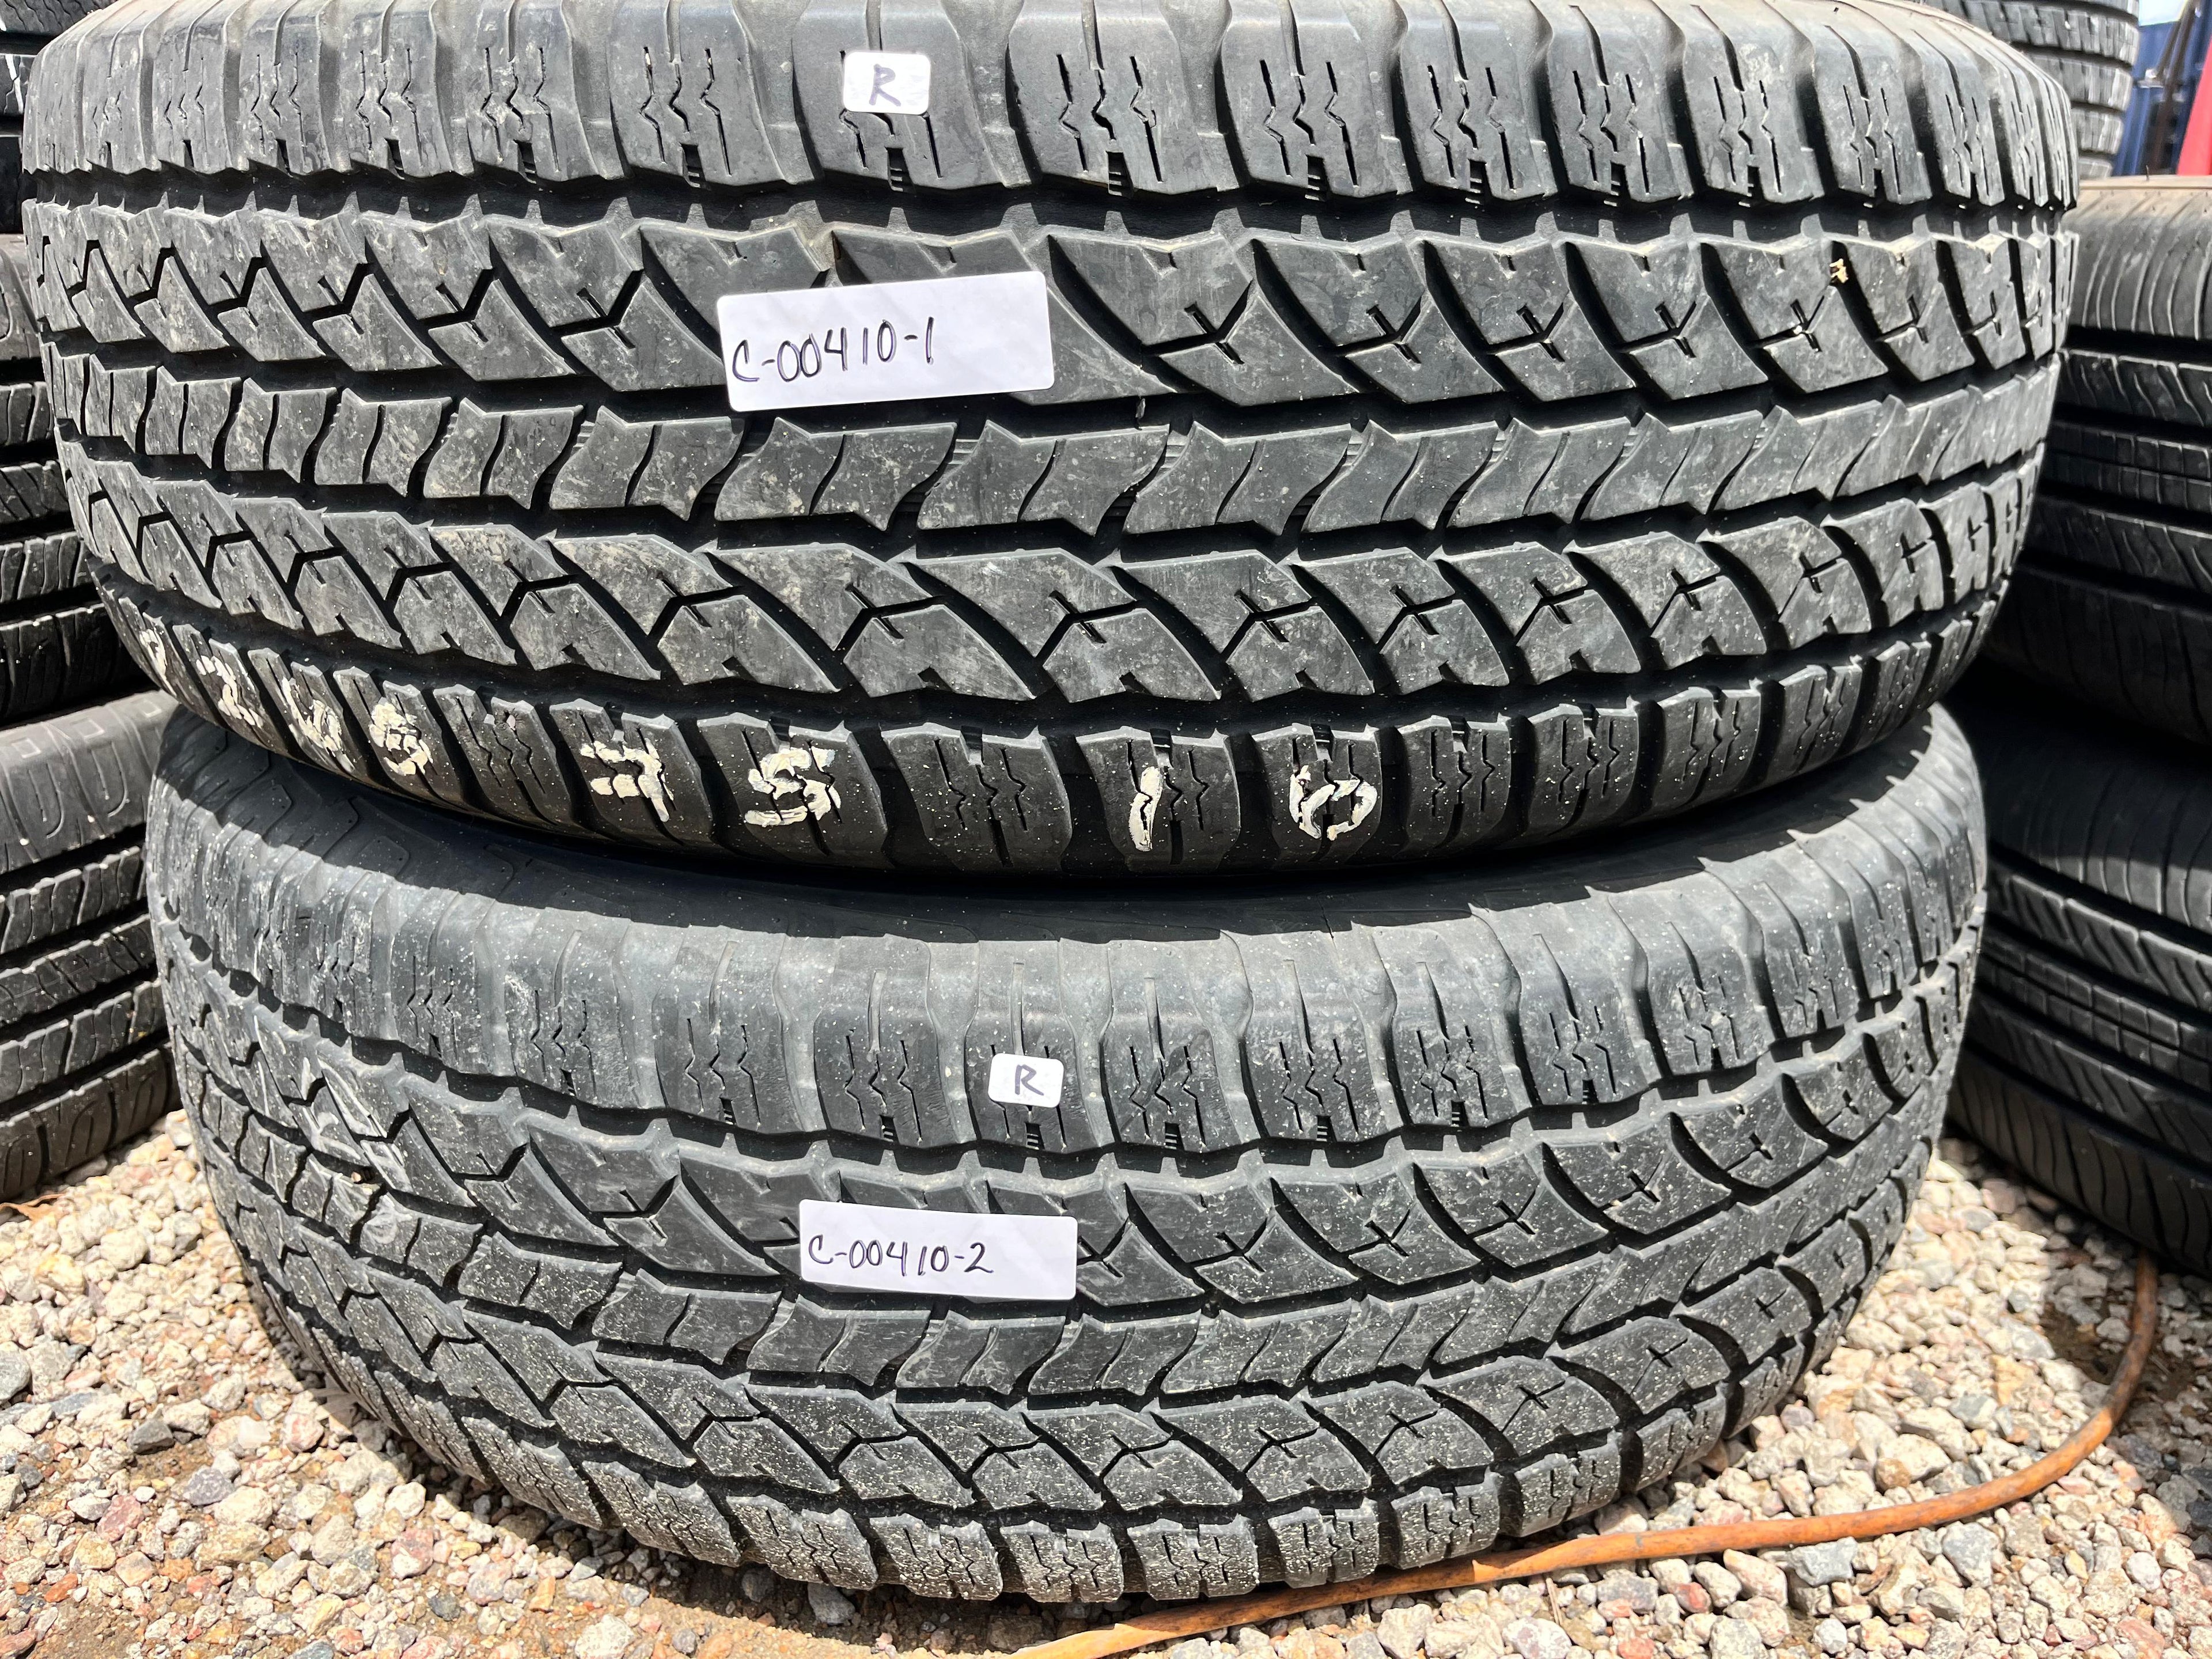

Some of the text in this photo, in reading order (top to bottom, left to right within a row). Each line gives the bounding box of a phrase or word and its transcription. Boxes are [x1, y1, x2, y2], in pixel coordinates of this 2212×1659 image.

[869, 63, 902, 107] R
[732, 316, 934, 382] C-00410-1
[1014, 1064, 1044, 1097] R
[808, 1234, 995, 1277] C-00410-2
